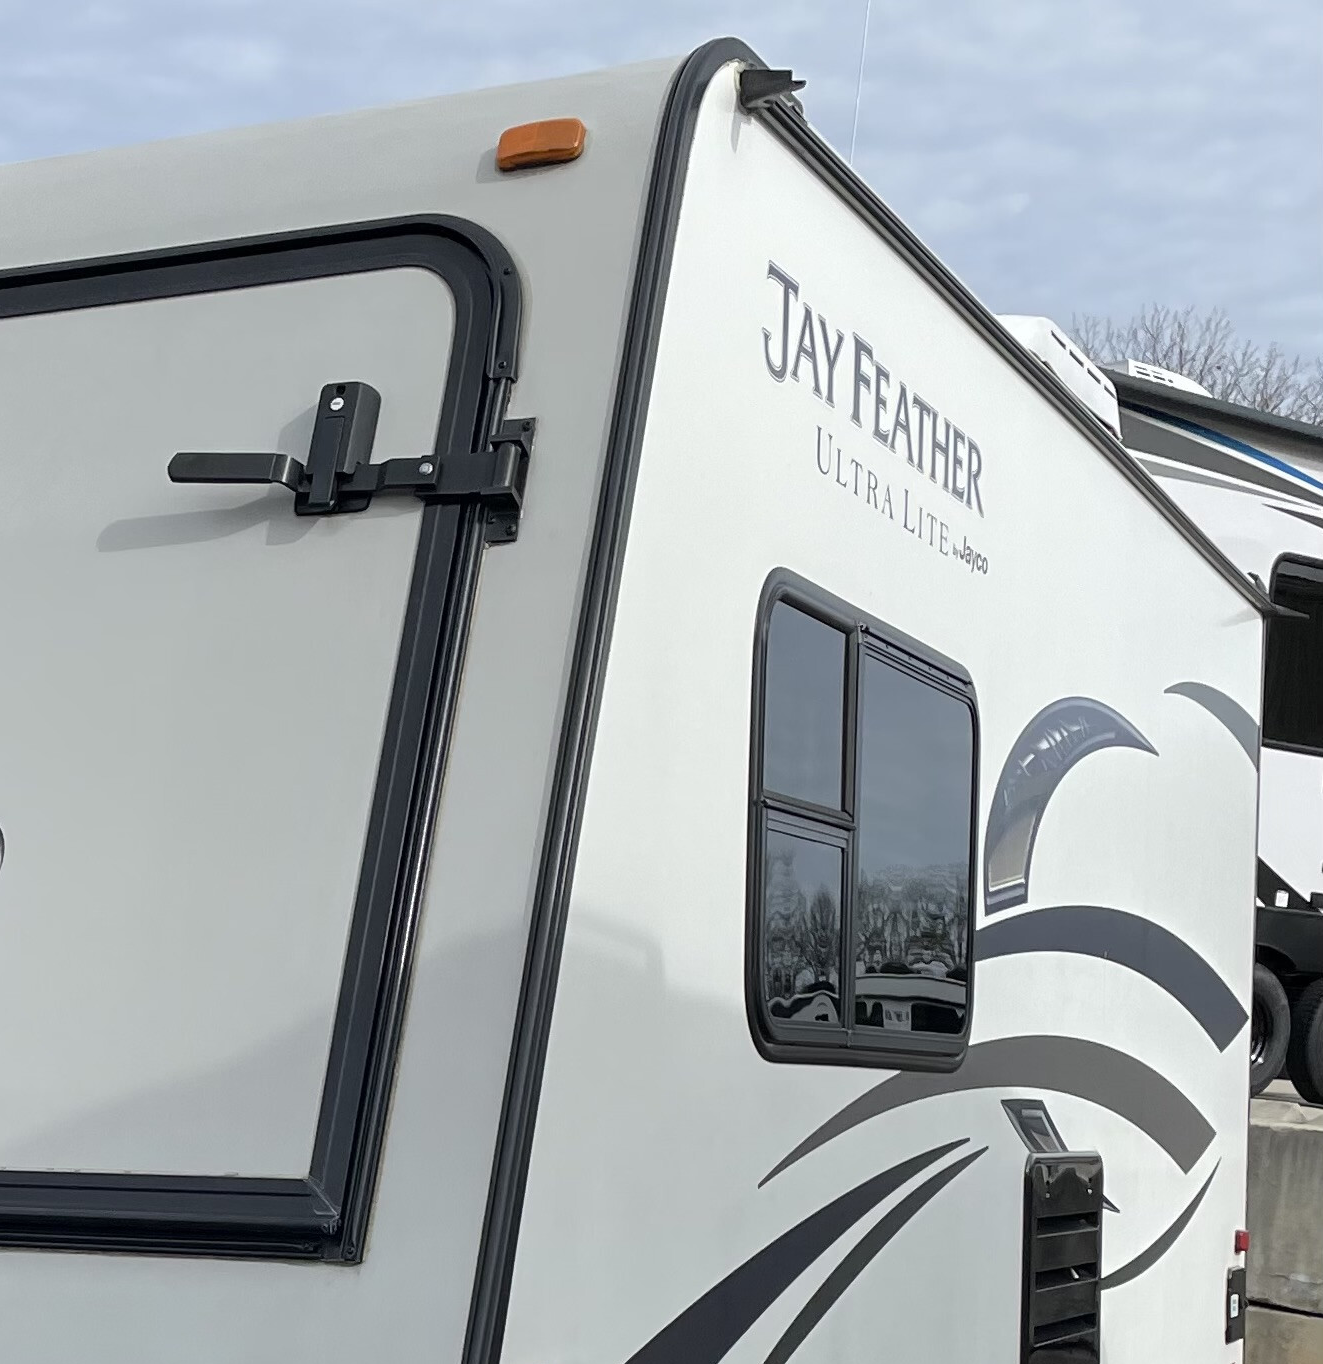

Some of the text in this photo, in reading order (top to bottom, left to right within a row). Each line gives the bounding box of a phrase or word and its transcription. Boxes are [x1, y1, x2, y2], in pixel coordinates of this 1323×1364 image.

[762, 260, 984, 518] JAY FEATHER
[816, 425, 894, 520] ULTRA
[903, 488, 949, 557] LITE
[959, 535, 988, 574] Jayco
